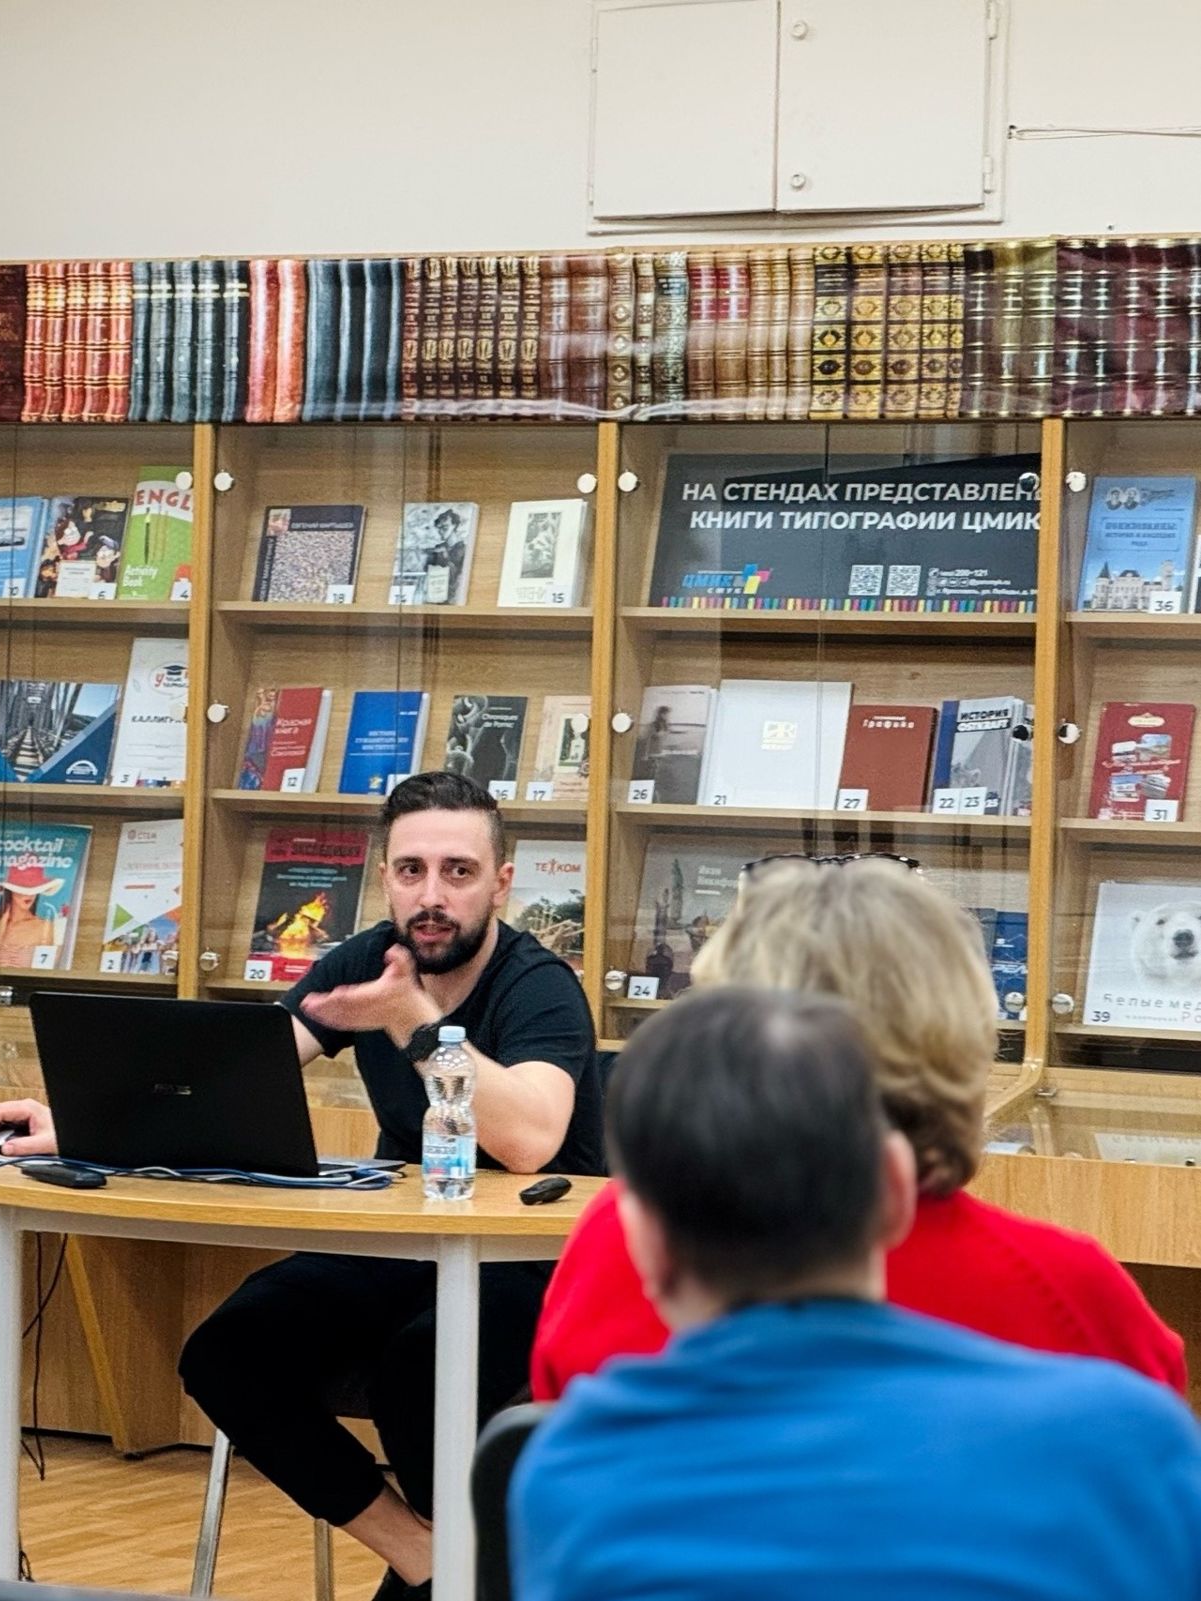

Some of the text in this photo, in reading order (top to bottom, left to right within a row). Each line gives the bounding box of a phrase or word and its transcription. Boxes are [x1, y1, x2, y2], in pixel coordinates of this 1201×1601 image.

[682, 483, 1040, 504] НА СТЕНДАХ ПРЕДСТАВЛЕН
[690, 511, 1041, 533] КНИГИ ТИПОГРАФИИ ЦМИК
[124, 564, 159, 577] Activity
[122, 576, 143, 587] Book
[180, 589, 189, 599] 4
[551, 592, 565, 603] 15
[1154, 600, 1174, 611] 36
[960, 708, 1009, 720] ИСТОРИЯ
[533, 789, 547, 800] 17
[632, 789, 648, 800] 26
[713, 794, 727, 805] 21
[843, 797, 861, 809] 27
[938, 797, 955, 808] 22
[964, 796, 980, 808] 23
[40, 954, 48, 964] 7
[249, 969, 265, 979] 20
[633, 985, 651, 996] 24
[1092, 1010, 1111, 1023] 39
